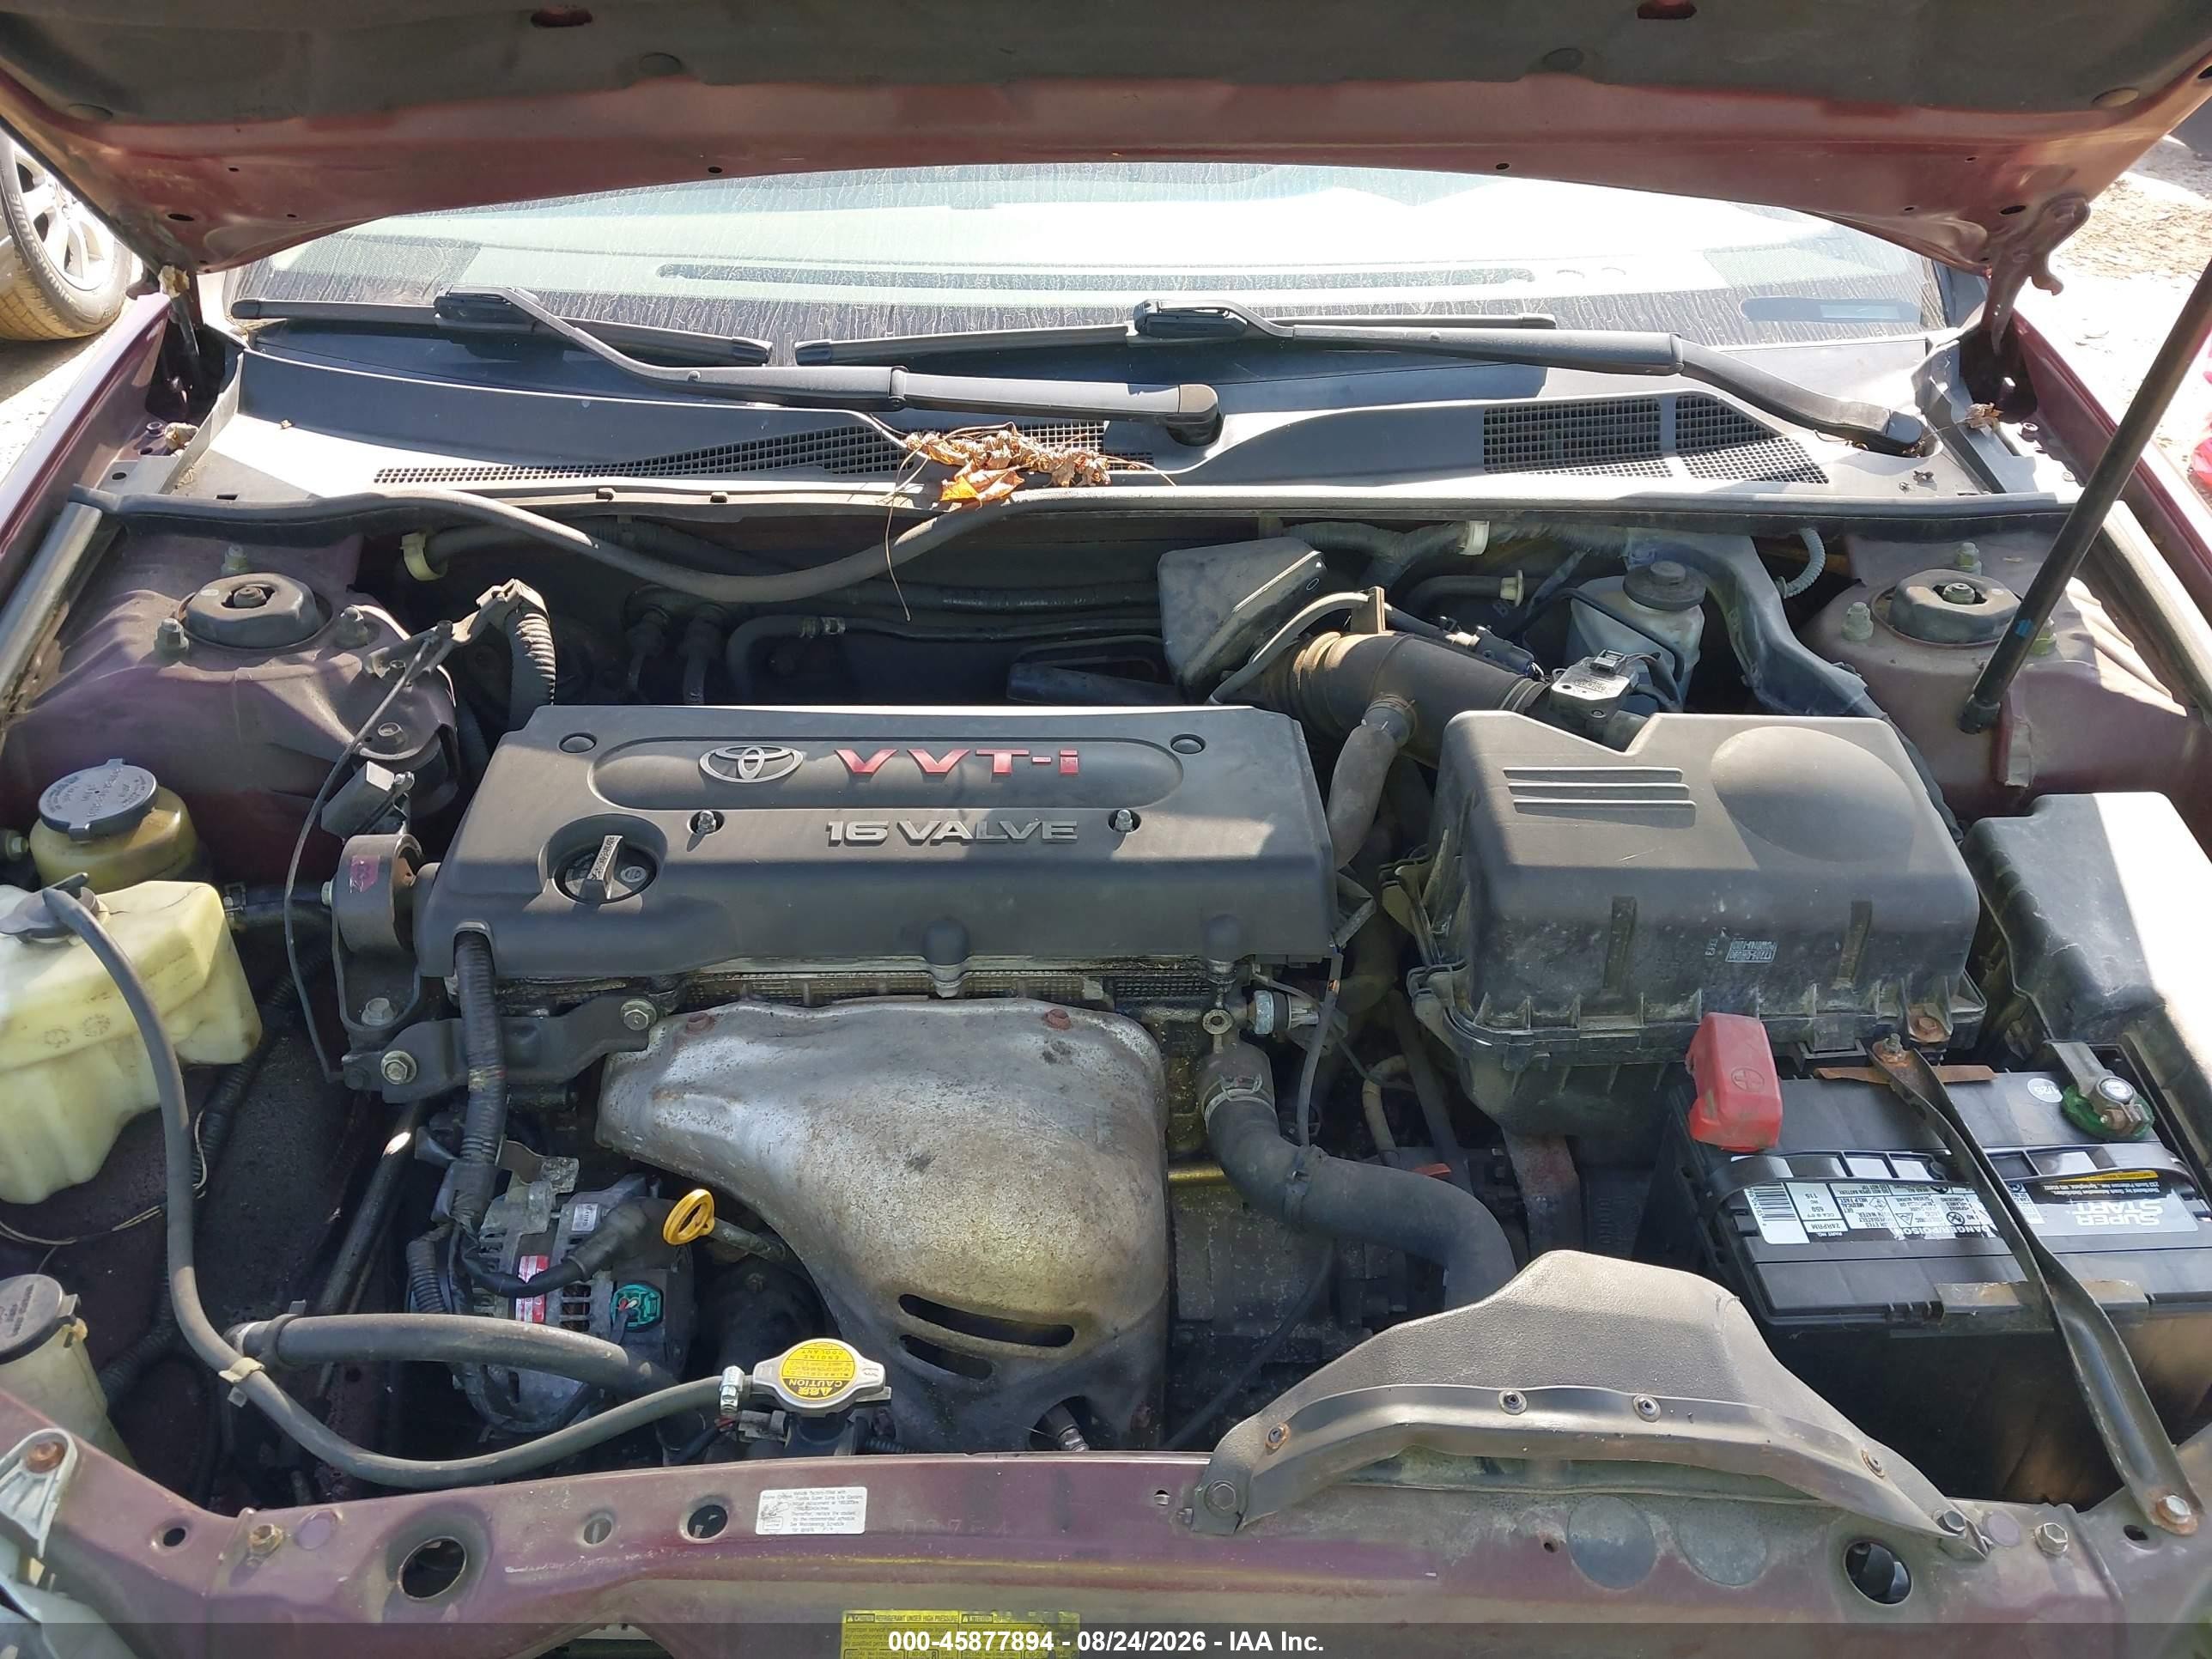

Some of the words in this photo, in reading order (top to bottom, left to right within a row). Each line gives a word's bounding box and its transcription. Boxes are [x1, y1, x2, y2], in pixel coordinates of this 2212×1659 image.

[835, 749, 1079, 775] VVT-i
[826, 820, 889, 845] 16
[898, 820, 1078, 845] VALVE
[2072, 1200, 2163, 1215] START
[2075, 1213, 2160, 1226] SUPER
[788, 1379, 843, 1388] CAUTION
